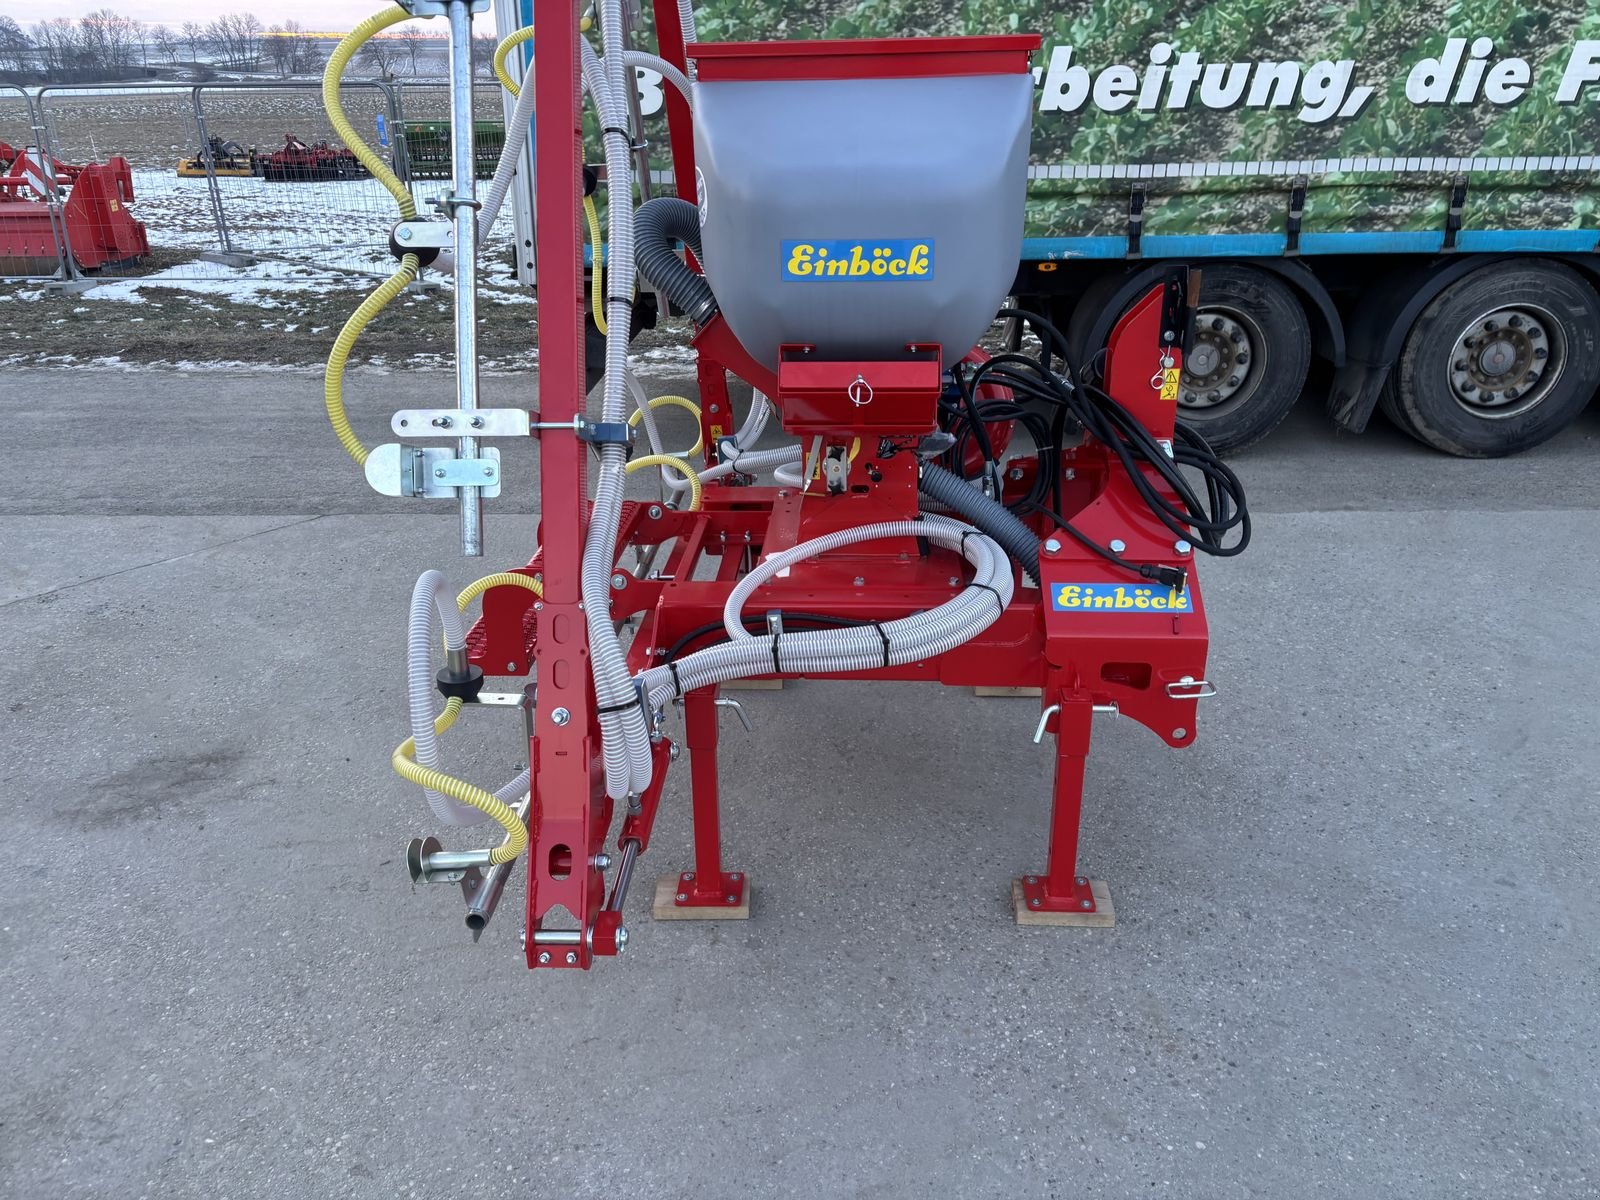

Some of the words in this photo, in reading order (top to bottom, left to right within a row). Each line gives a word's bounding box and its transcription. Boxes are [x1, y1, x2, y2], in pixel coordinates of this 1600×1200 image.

[1405, 38, 1530, 104] die
[1554, 40, 1600, 102] F
[787, 244, 929, 276] Einböck
[1057, 585, 1188, 609] Einböck
